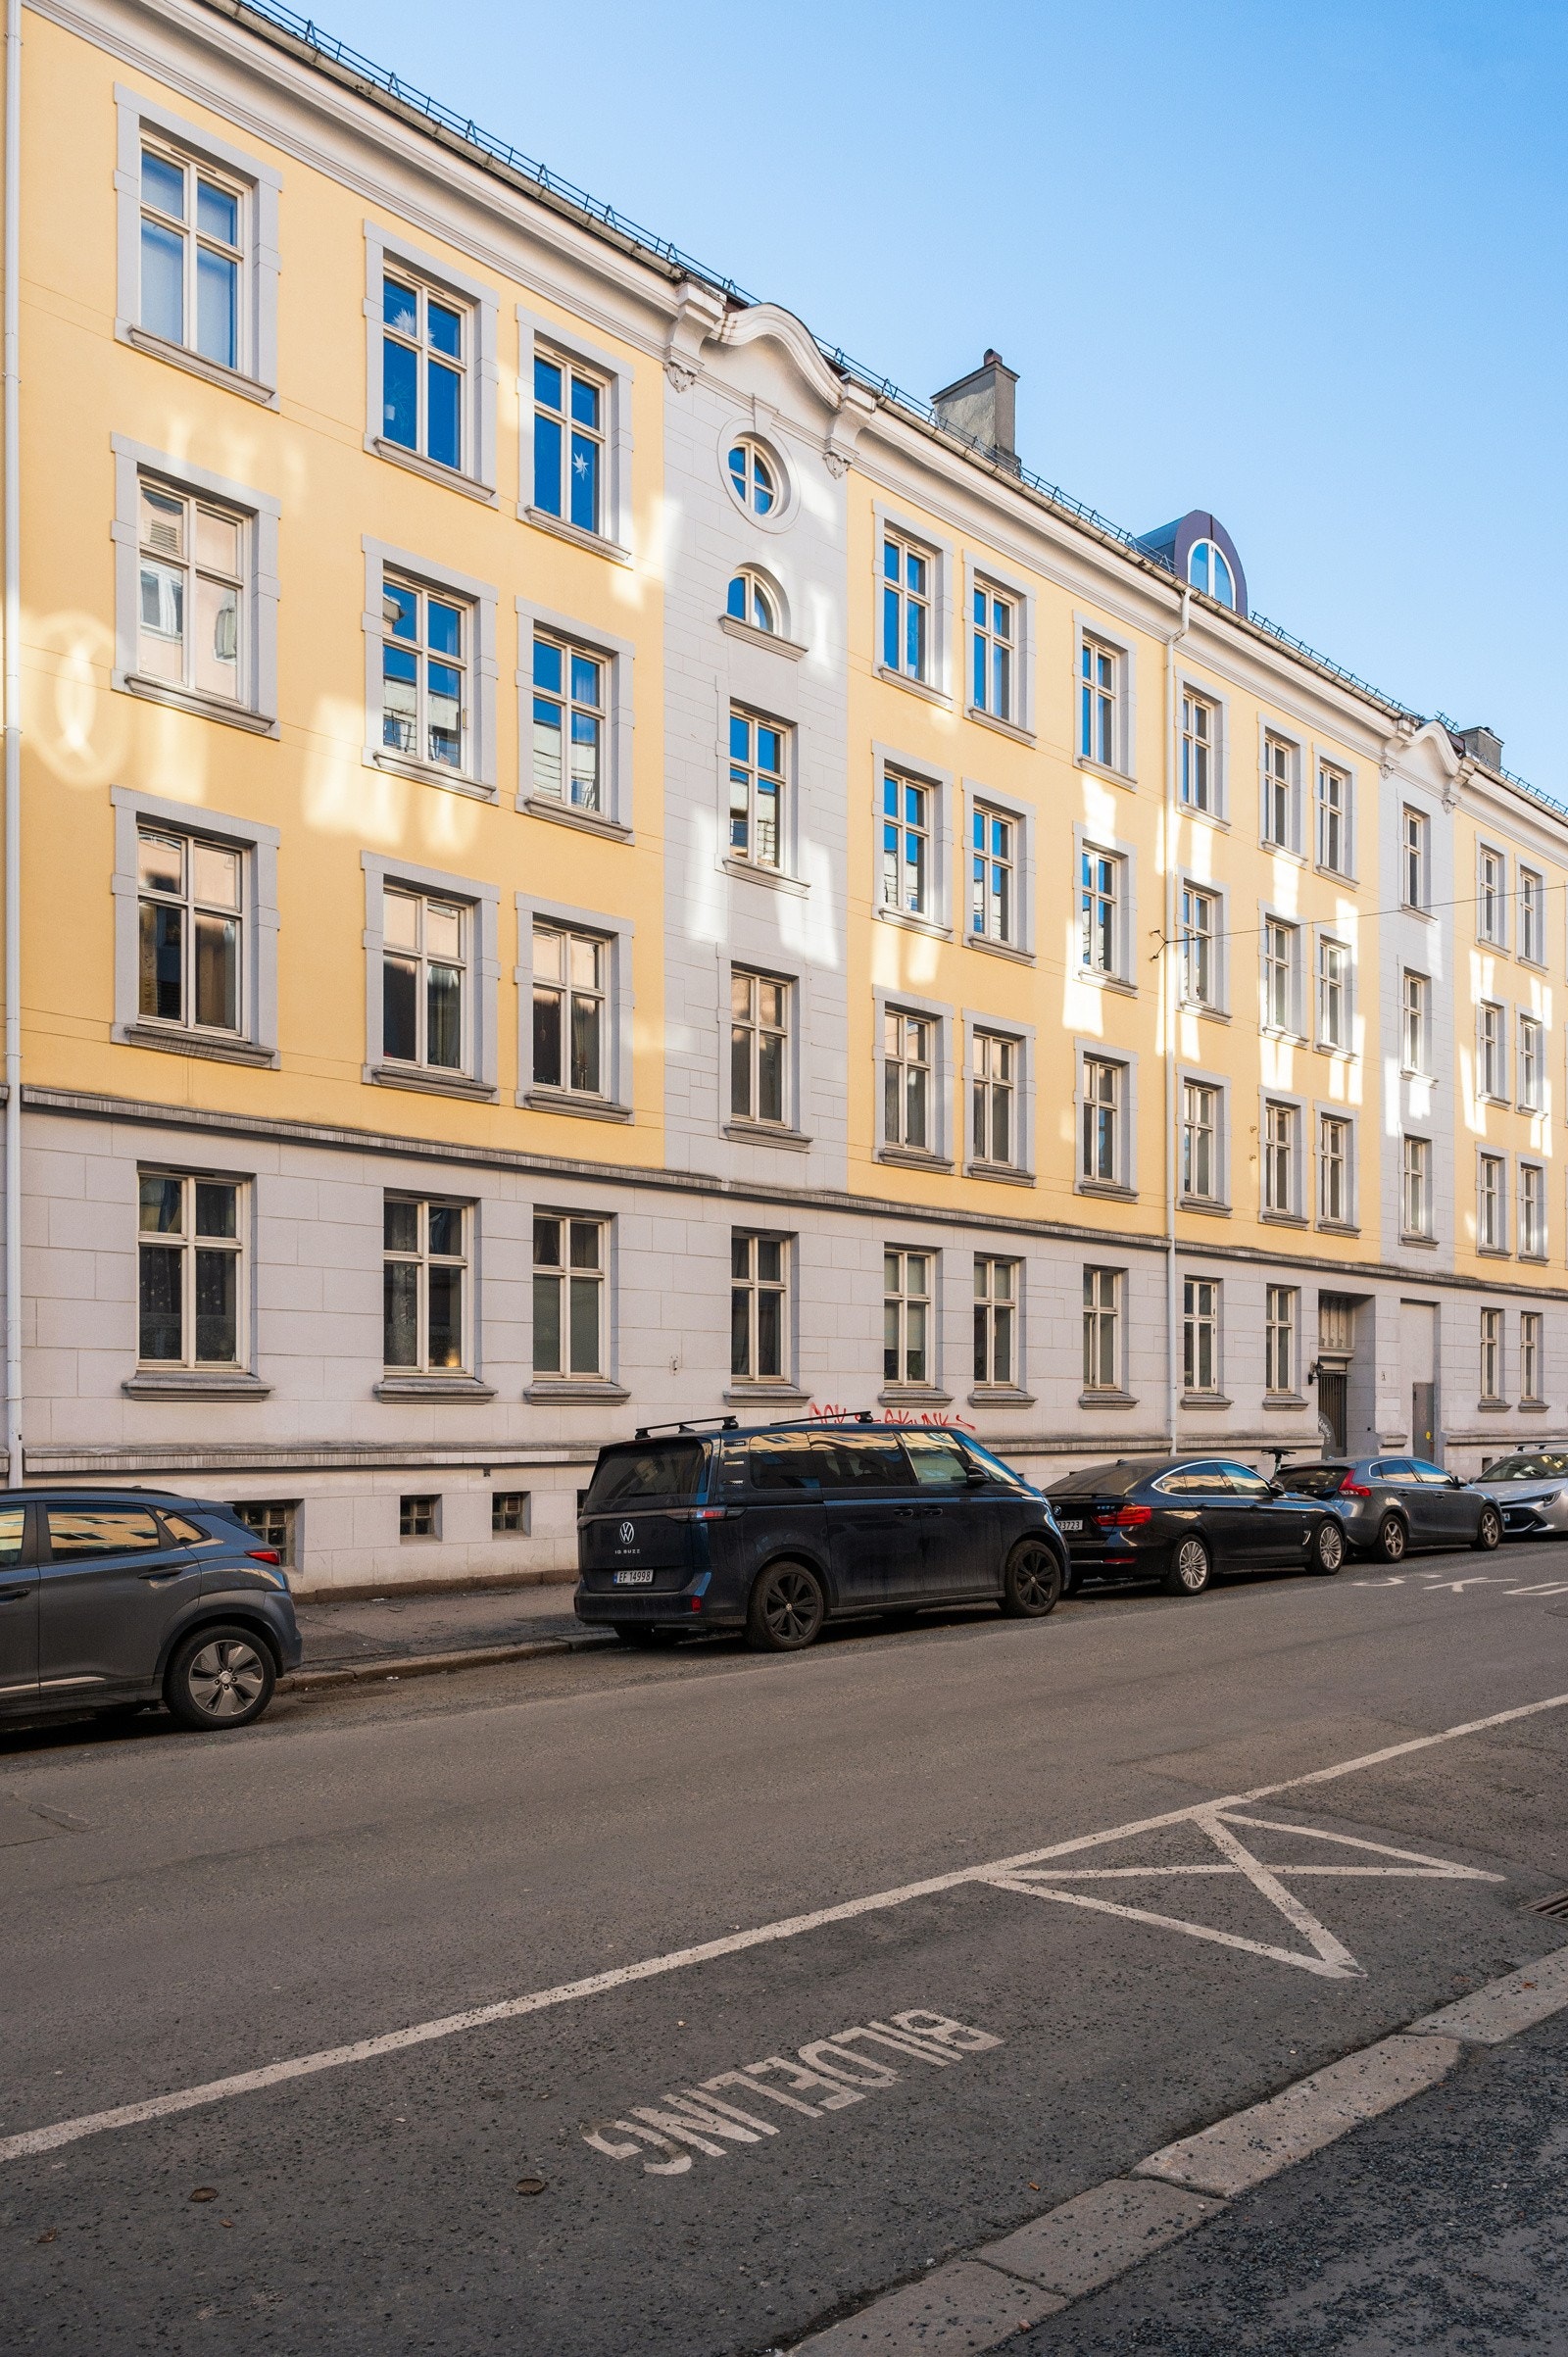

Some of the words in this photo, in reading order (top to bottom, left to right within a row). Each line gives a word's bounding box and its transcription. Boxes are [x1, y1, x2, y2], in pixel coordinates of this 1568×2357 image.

[1057, 1521, 1080, 1530] 23723
[618, 1572, 627, 1582] EF
[629, 1571, 651, 1581] 14998
[578, 2009, 1005, 2176] BILDELING
